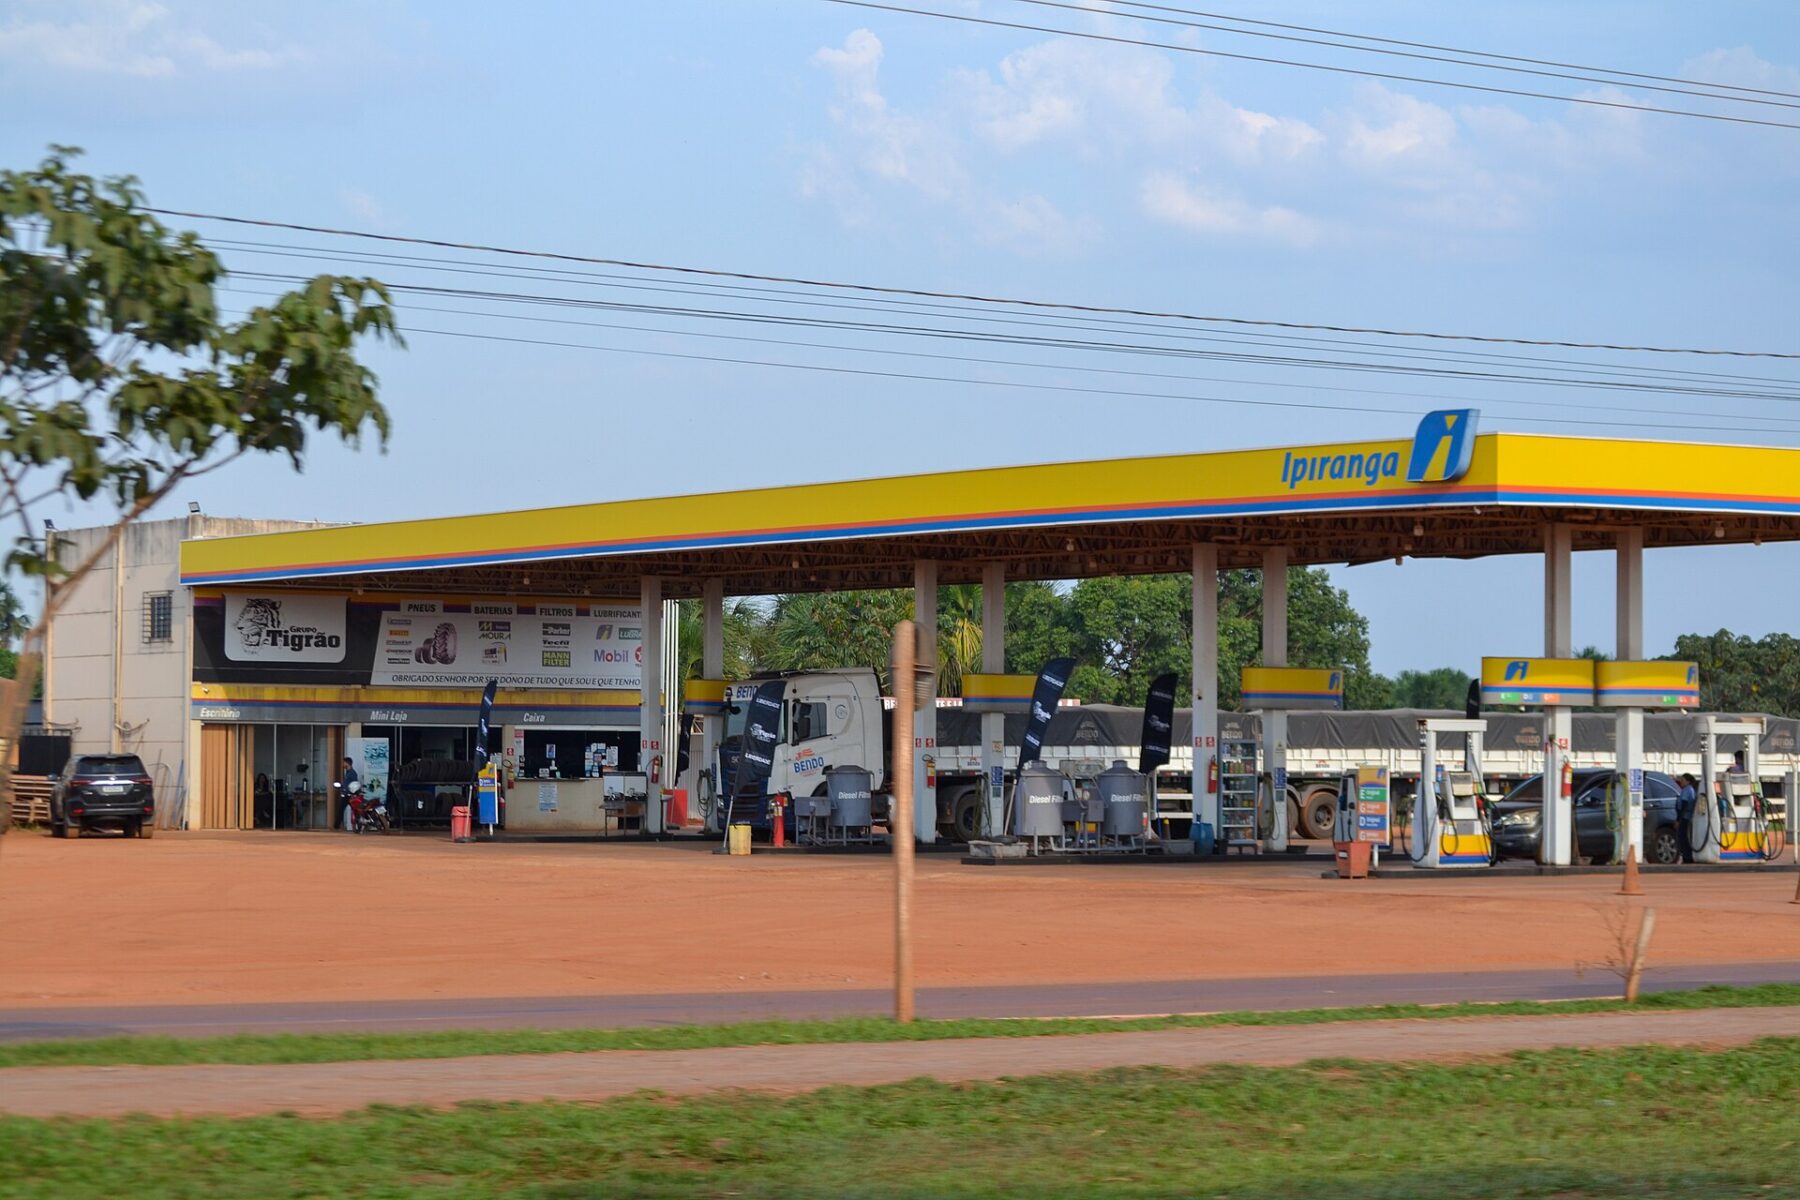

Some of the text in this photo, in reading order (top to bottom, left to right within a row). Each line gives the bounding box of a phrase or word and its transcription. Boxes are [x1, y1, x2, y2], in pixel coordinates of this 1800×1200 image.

[1281, 452, 1400, 489] Ipiranga
[407, 604, 436, 613] PNEUS
[474, 606, 513, 615] BATERIAS
[540, 608, 573, 617] FILTROS
[594, 610, 641, 618] LUBRIFICANT
[289, 626, 317, 634] GRUPO
[478, 632, 511, 640] MOURA
[266, 632, 340, 652] Tigrão
[594, 649, 629, 663] Mobil
[435, 675, 467, 683] SENHOR
[559, 677, 575, 686] QUE
[597, 678, 614, 686] QUE
[615, 678, 641, 686] TENHO
[736, 685, 759, 699] BEND
[370, 711, 408, 722] Mini Loja
[523, 713, 546, 723] Caixa
[793, 756, 825, 774] BENDO
[838, 791, 857, 800] Diesel
[1029, 795, 1051, 804] Diesel
[1110, 793, 1132, 802] Diesel
